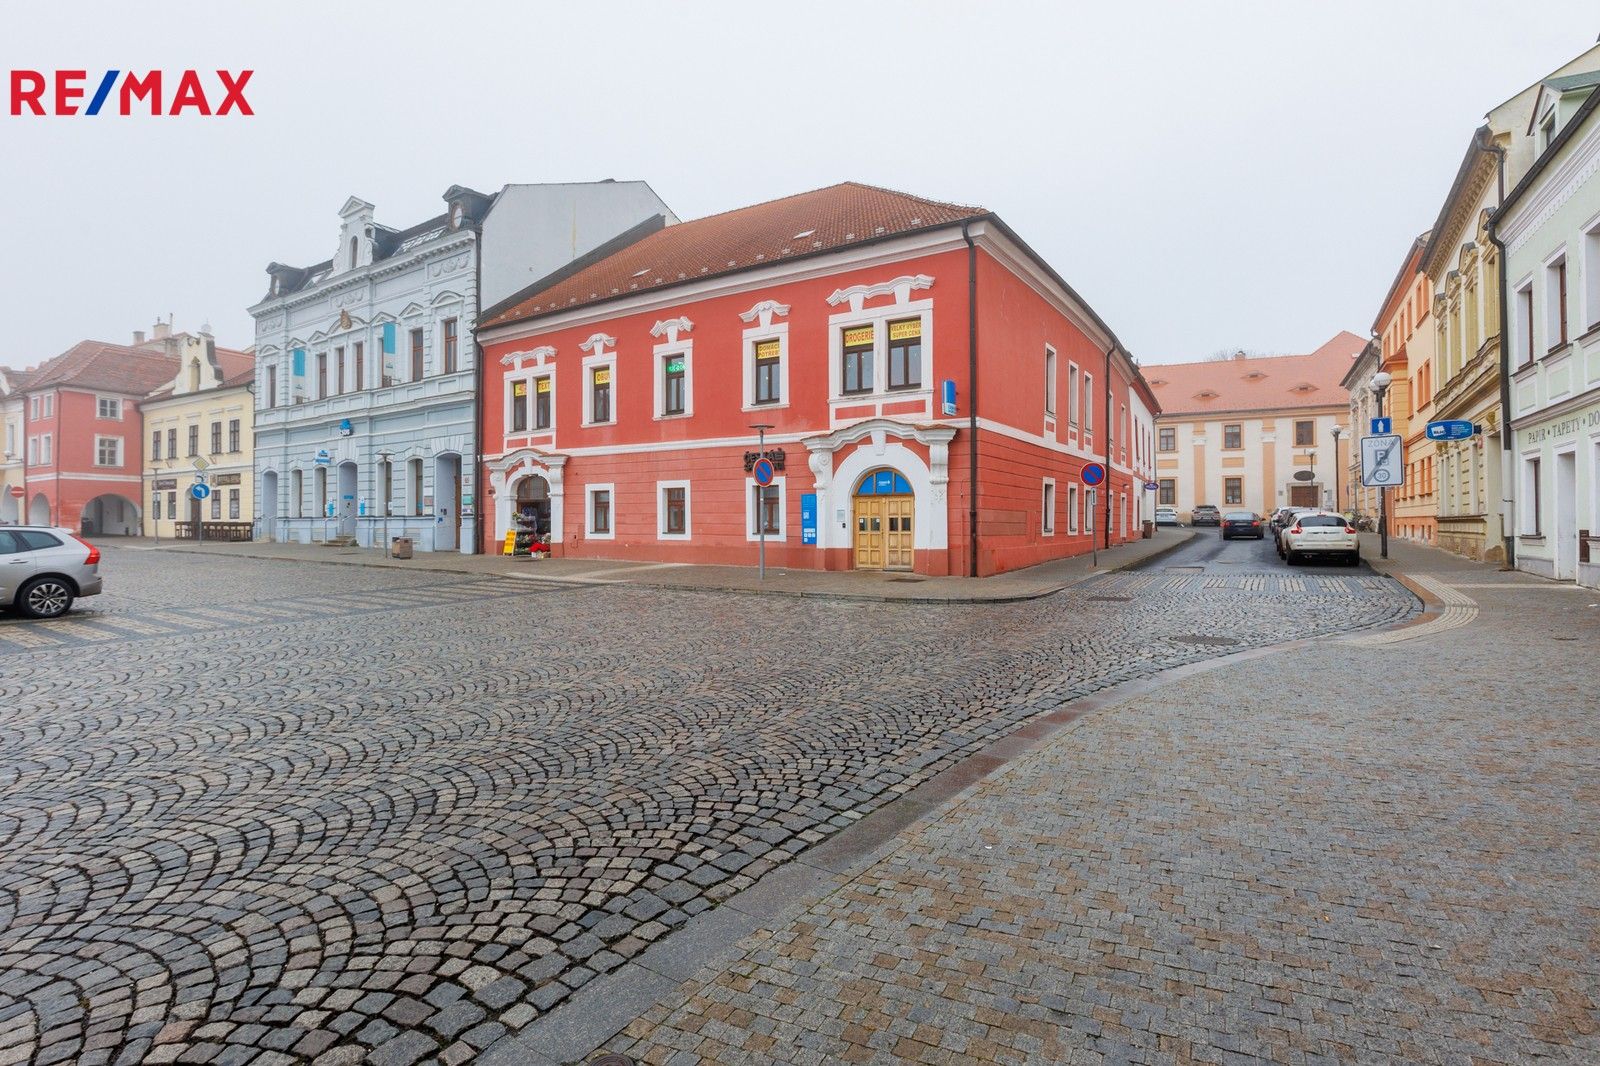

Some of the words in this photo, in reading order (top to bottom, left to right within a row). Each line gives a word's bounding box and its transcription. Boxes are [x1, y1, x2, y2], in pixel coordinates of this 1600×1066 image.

[845, 329, 874, 343] DROGERIE
[1552, 417, 1580, 437] TAPETY
[1367, 439, 1396, 448] ZONA
